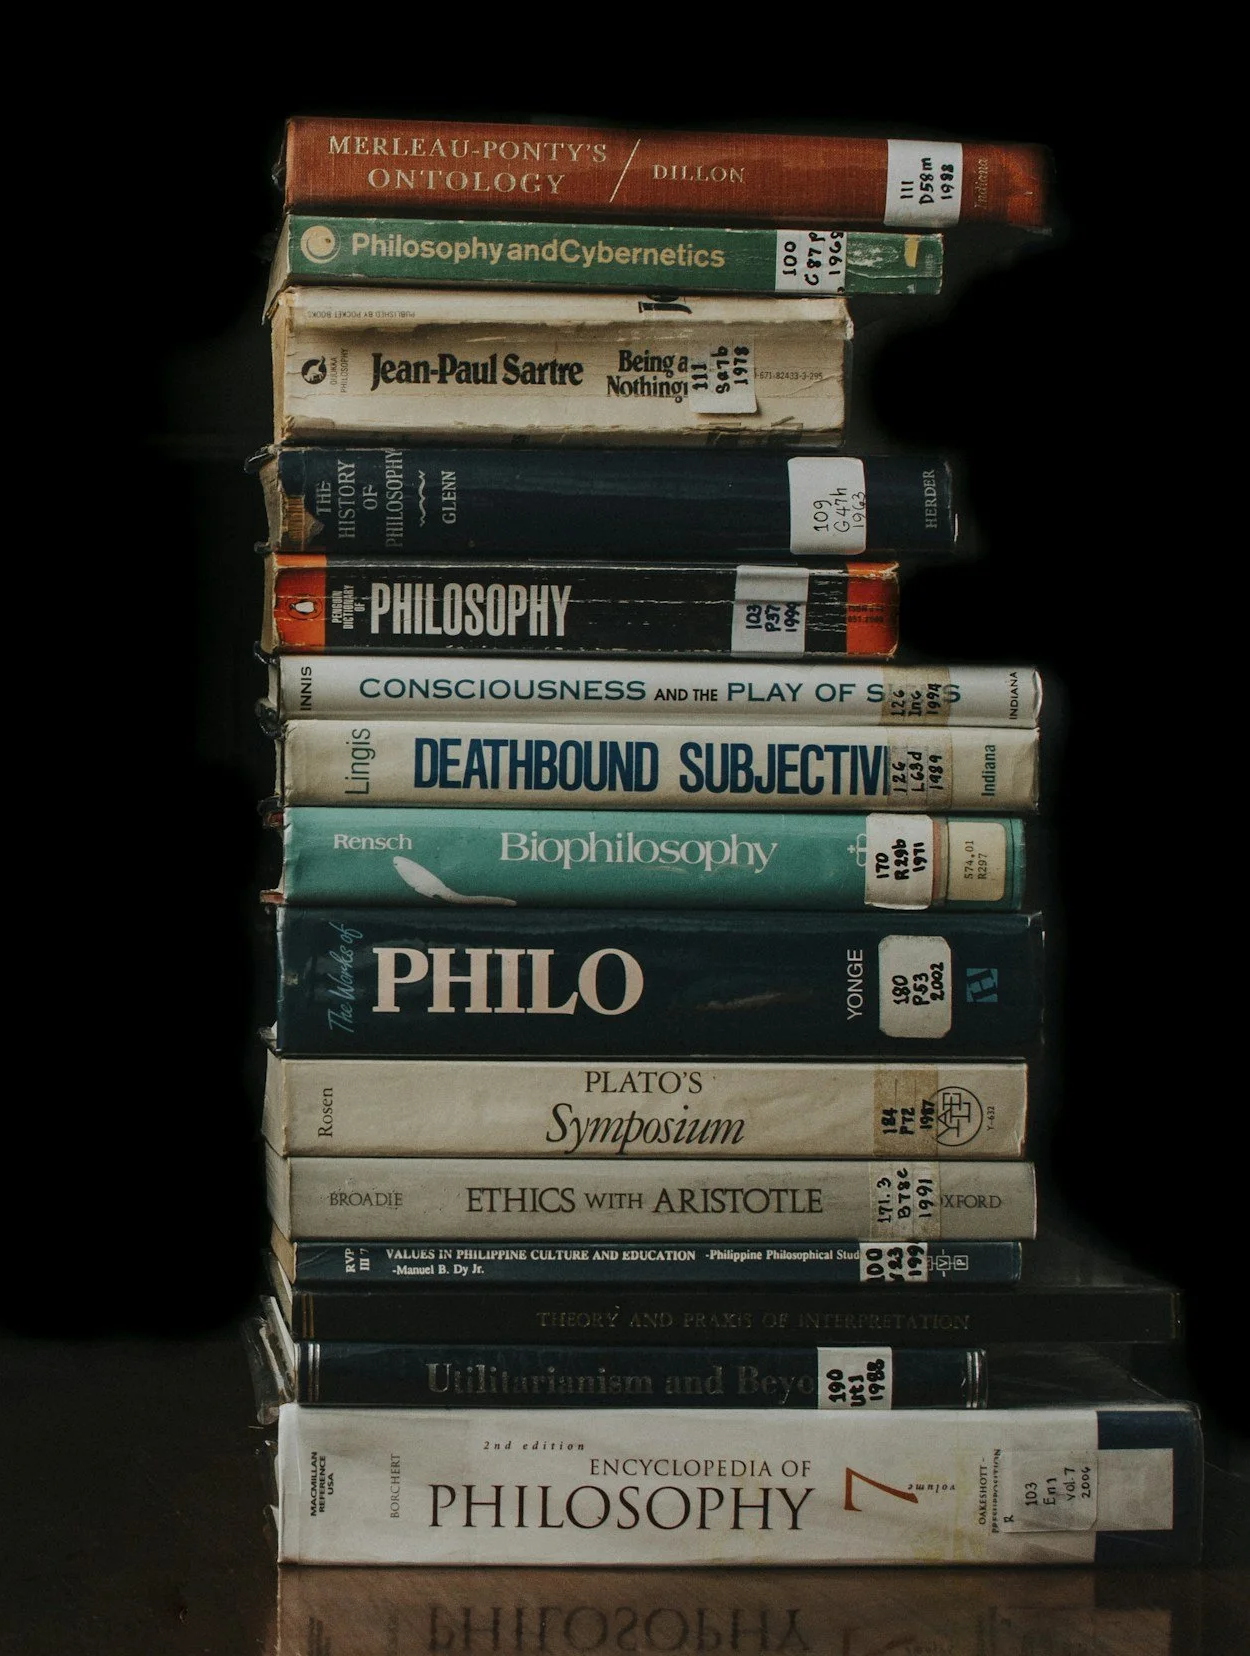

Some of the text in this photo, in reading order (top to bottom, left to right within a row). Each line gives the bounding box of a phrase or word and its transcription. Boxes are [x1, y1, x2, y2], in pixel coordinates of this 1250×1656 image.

[328, 135, 607, 163] MERLEAU-PONTY'S
[366, 168, 565, 195] ONTOLOGY
[652, 164, 745, 184] DILLON
[973, 158, 989, 209] Indiana
[782, 241, 796, 276] 100
[334, 310, 361, 319] POCKET
[364, 310, 374, 319] BY
[340, 348, 348, 393] PHILOSOPHY
[371, 353, 584, 391] Jean-Paul Sartre
[618, 350, 674, 378] Being
[316, 480, 332, 515] THE
[338, 459, 356, 539] HISTORY
[362, 484, 378, 511] OF
[386, 450, 404, 548] PHILOSOPHY
[442, 470, 457, 524] GLENN
[923, 469, 938, 529] HERDER
[814, 500, 831, 533] 109
[332, 590, 343, 625] PENGUIN
[343, 584, 354, 630] DICTIONARY
[354, 602, 365, 613] OF
[371, 582, 571, 636] PHILOSOPHY
[746, 605, 762, 630] 103
[300, 666, 312, 711] INNIS
[360, 678, 646, 700] CONSCIOUSNESS
[654, 688, 691, 702] AND
[693, 688, 718, 702] THE
[728, 682, 803, 702] PLAY
[815, 682, 855, 702] OF
[1009, 672, 1018, 720] INDIANA
[344, 728, 376, 795] Lingis
[414, 738, 890, 796] DEATHBOUND SUBJECTIVI
[981, 744, 996, 797] Indiana
[334, 831, 778, 874] Rensch Biophilosophy
[876, 852, 889, 879] 170
[964, 840, 975, 880] 574.01
[978, 852, 988, 881] R297
[327, 922, 364, 1033] The Works of
[372, 947, 644, 1016] PHILO
[847, 949, 863, 1021] YONGE
[892, 974, 909, 1006] 180
[930, 962, 945, 1002] 2002
[584, 1070, 703, 1094] PLATO'S
[318, 1086, 334, 1138] Rosen
[546, 1102, 746, 1155] Symposium
[987, 1106, 995, 1131] Y-632
[330, 1192, 403, 1207] BROADIE
[466, 1187, 823, 1214] ETHICS WITH ARISTOTLE
[346, 1248, 356, 1273] RVP
[386, 1248, 436, 1261] VALUES
[438, 1249, 453, 1260] IN
[456, 1250, 527, 1261] PHILIPPINE
[530, 1250, 589, 1261] CULTURE
[592, 1250, 619, 1261] AND
[622, 1250, 696, 1261] EDUCATION
[705, 1250, 763, 1263] -Philippine
[766, 1249, 833, 1263] Philosophical
[392, 1263, 485, 1278] -Manuel B. Dy Jr.
[907, 1242, 924, 1277] 199
[536, 1312, 970, 1331] THEORY AND PRAXIS OF INTERPRETATION
[426, 1363, 652, 1395] Utilitarianism
[666, 1365, 724, 1395] and
[827, 1368, 848, 1403] 190
[867, 1358, 885, 1402] 1988
[482, 1440, 586, 1452] 2nd edition
[310, 1451, 319, 1517] MACMILLAN
[318, 1455, 327, 1514] REFERENCE
[590, 1458, 812, 1478] ENCYCLOPEDIA OF
[390, 1453, 401, 1519] BORCHERT
[908, 1482, 956, 1492] volume
[978, 1464, 988, 1526] OAKESHOTT
[1025, 1482, 1038, 1507] 103
[428, 1484, 816, 1530] PHILOSOPHY
